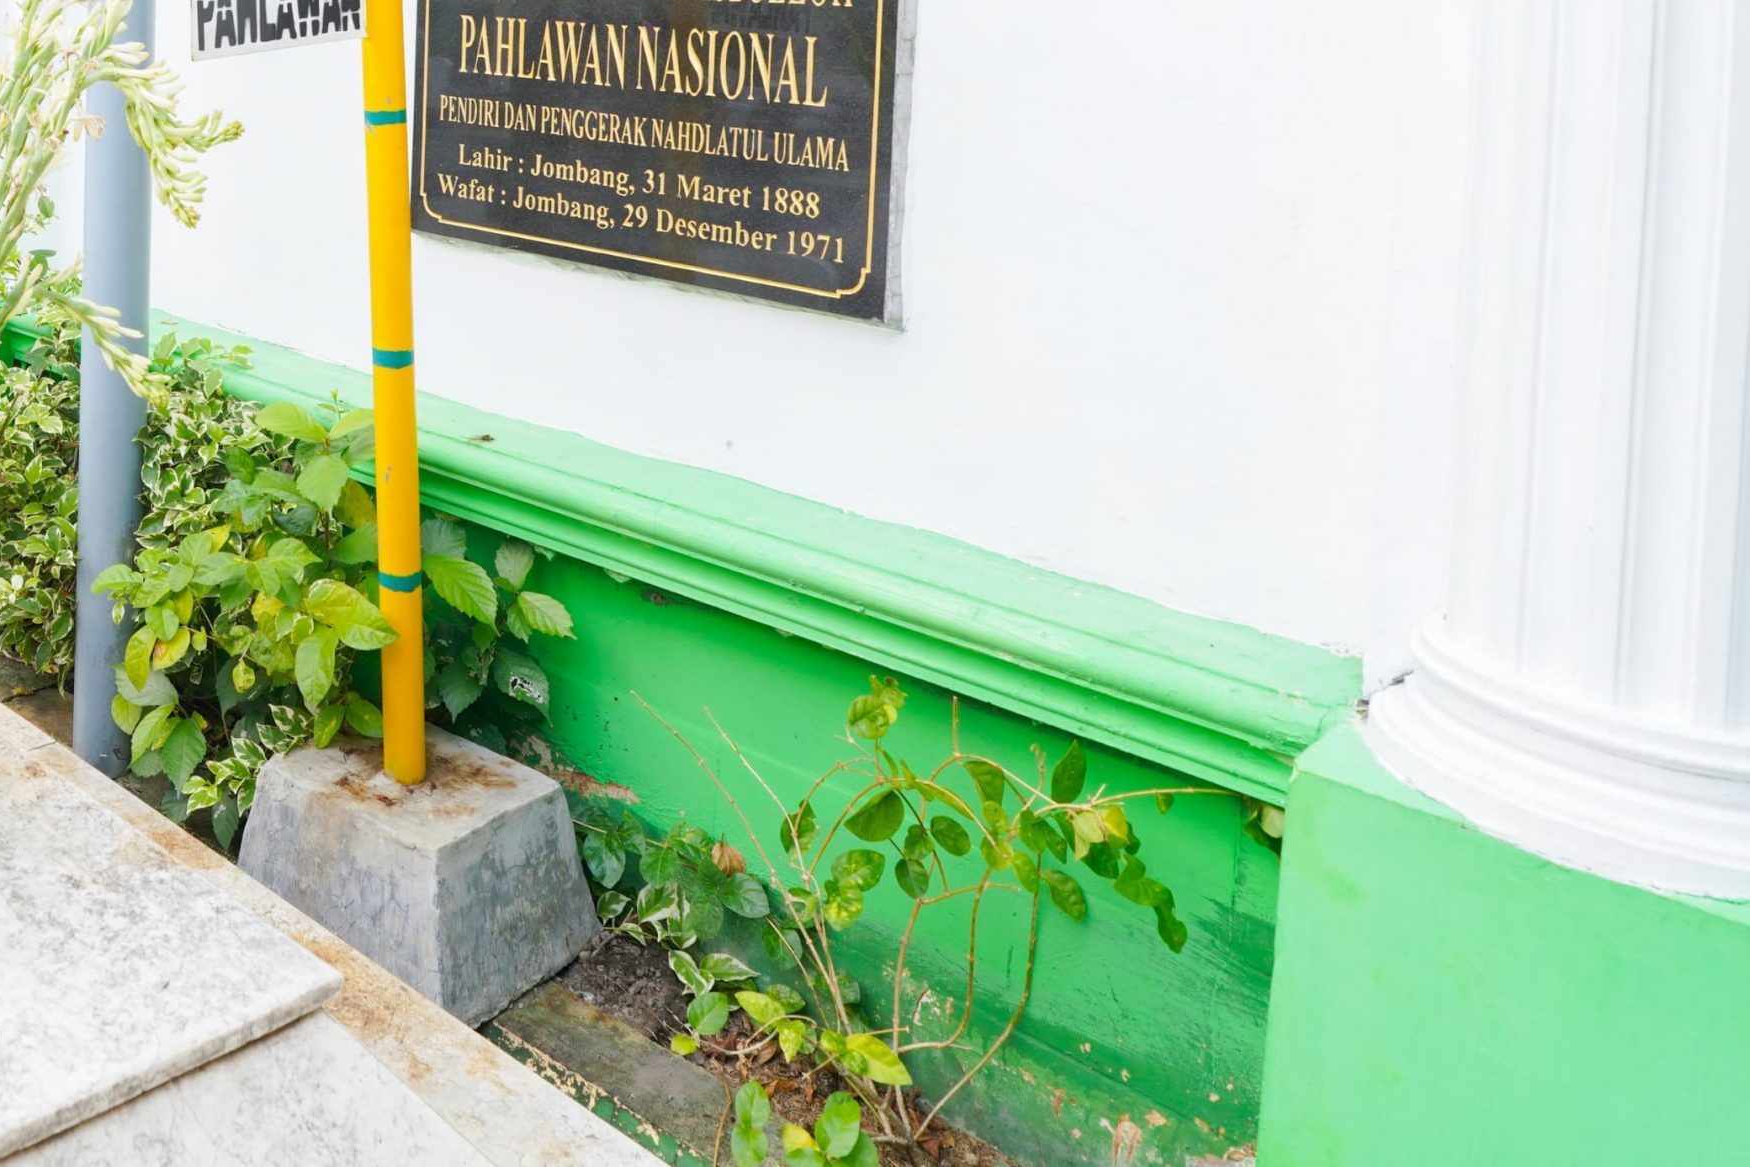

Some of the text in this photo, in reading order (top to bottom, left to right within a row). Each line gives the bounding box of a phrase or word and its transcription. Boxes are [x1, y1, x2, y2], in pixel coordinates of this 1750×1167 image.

[459, 14, 827, 107] PAHLAWAN NASIONAL
[439, 94, 850, 172] PENDIRI DAN PENGGERAK NAHDLATUL ULAMA
[437, 173, 495, 203] Wafat
[513, 186, 615, 229] Jombang,
[623, 203, 648, 228] 29
[656, 208, 778, 253] Desember
[787, 230, 845, 263] 1971
[458, 143, 513, 173] Lahir
[531, 154, 636, 196] Jombang,
[641, 169, 666, 195] 31
[676, 175, 752, 209] Maret
[762, 186, 820, 219] 1888
